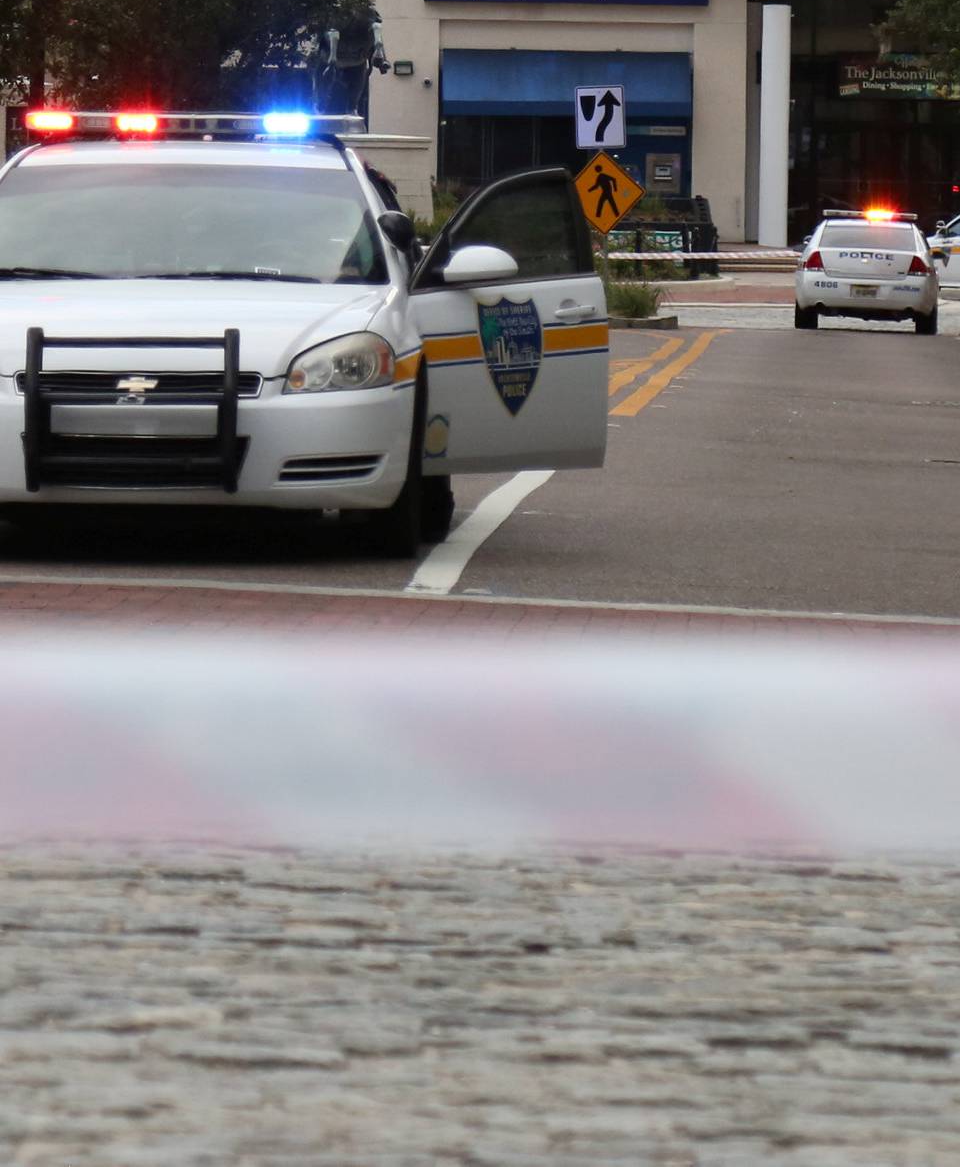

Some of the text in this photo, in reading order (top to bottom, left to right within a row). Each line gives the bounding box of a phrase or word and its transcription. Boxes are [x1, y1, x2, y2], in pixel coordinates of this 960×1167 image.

[845, 66, 868, 79] The
[862, 81, 886, 91] Dining
[890, 82, 922, 93] Shopping
[839, 252, 895, 261] POLICE
